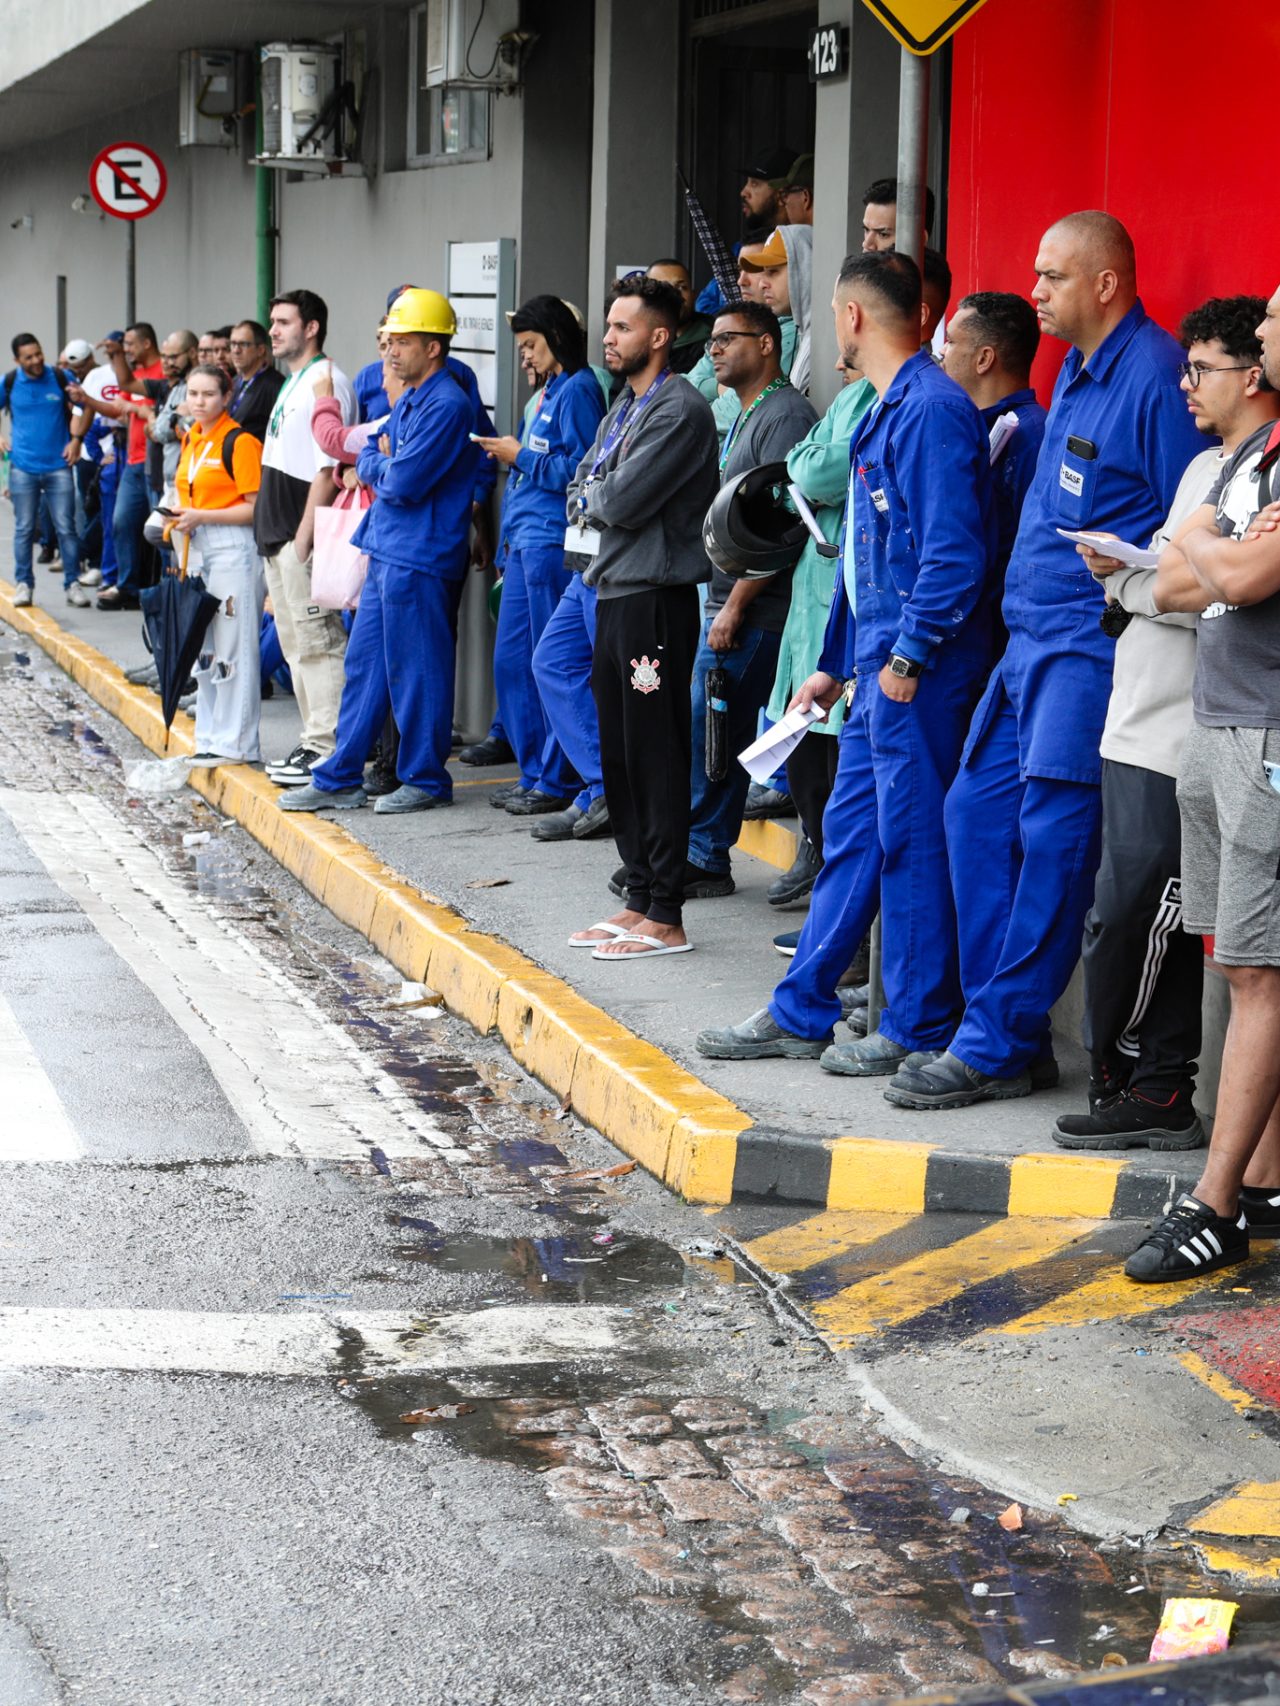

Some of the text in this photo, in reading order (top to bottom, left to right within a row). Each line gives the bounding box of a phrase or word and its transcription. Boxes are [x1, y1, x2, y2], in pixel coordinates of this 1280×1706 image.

[813, 29, 837, 75] 123
[113, 161, 144, 199] E
[1064, 470, 1081, 484] BASF
